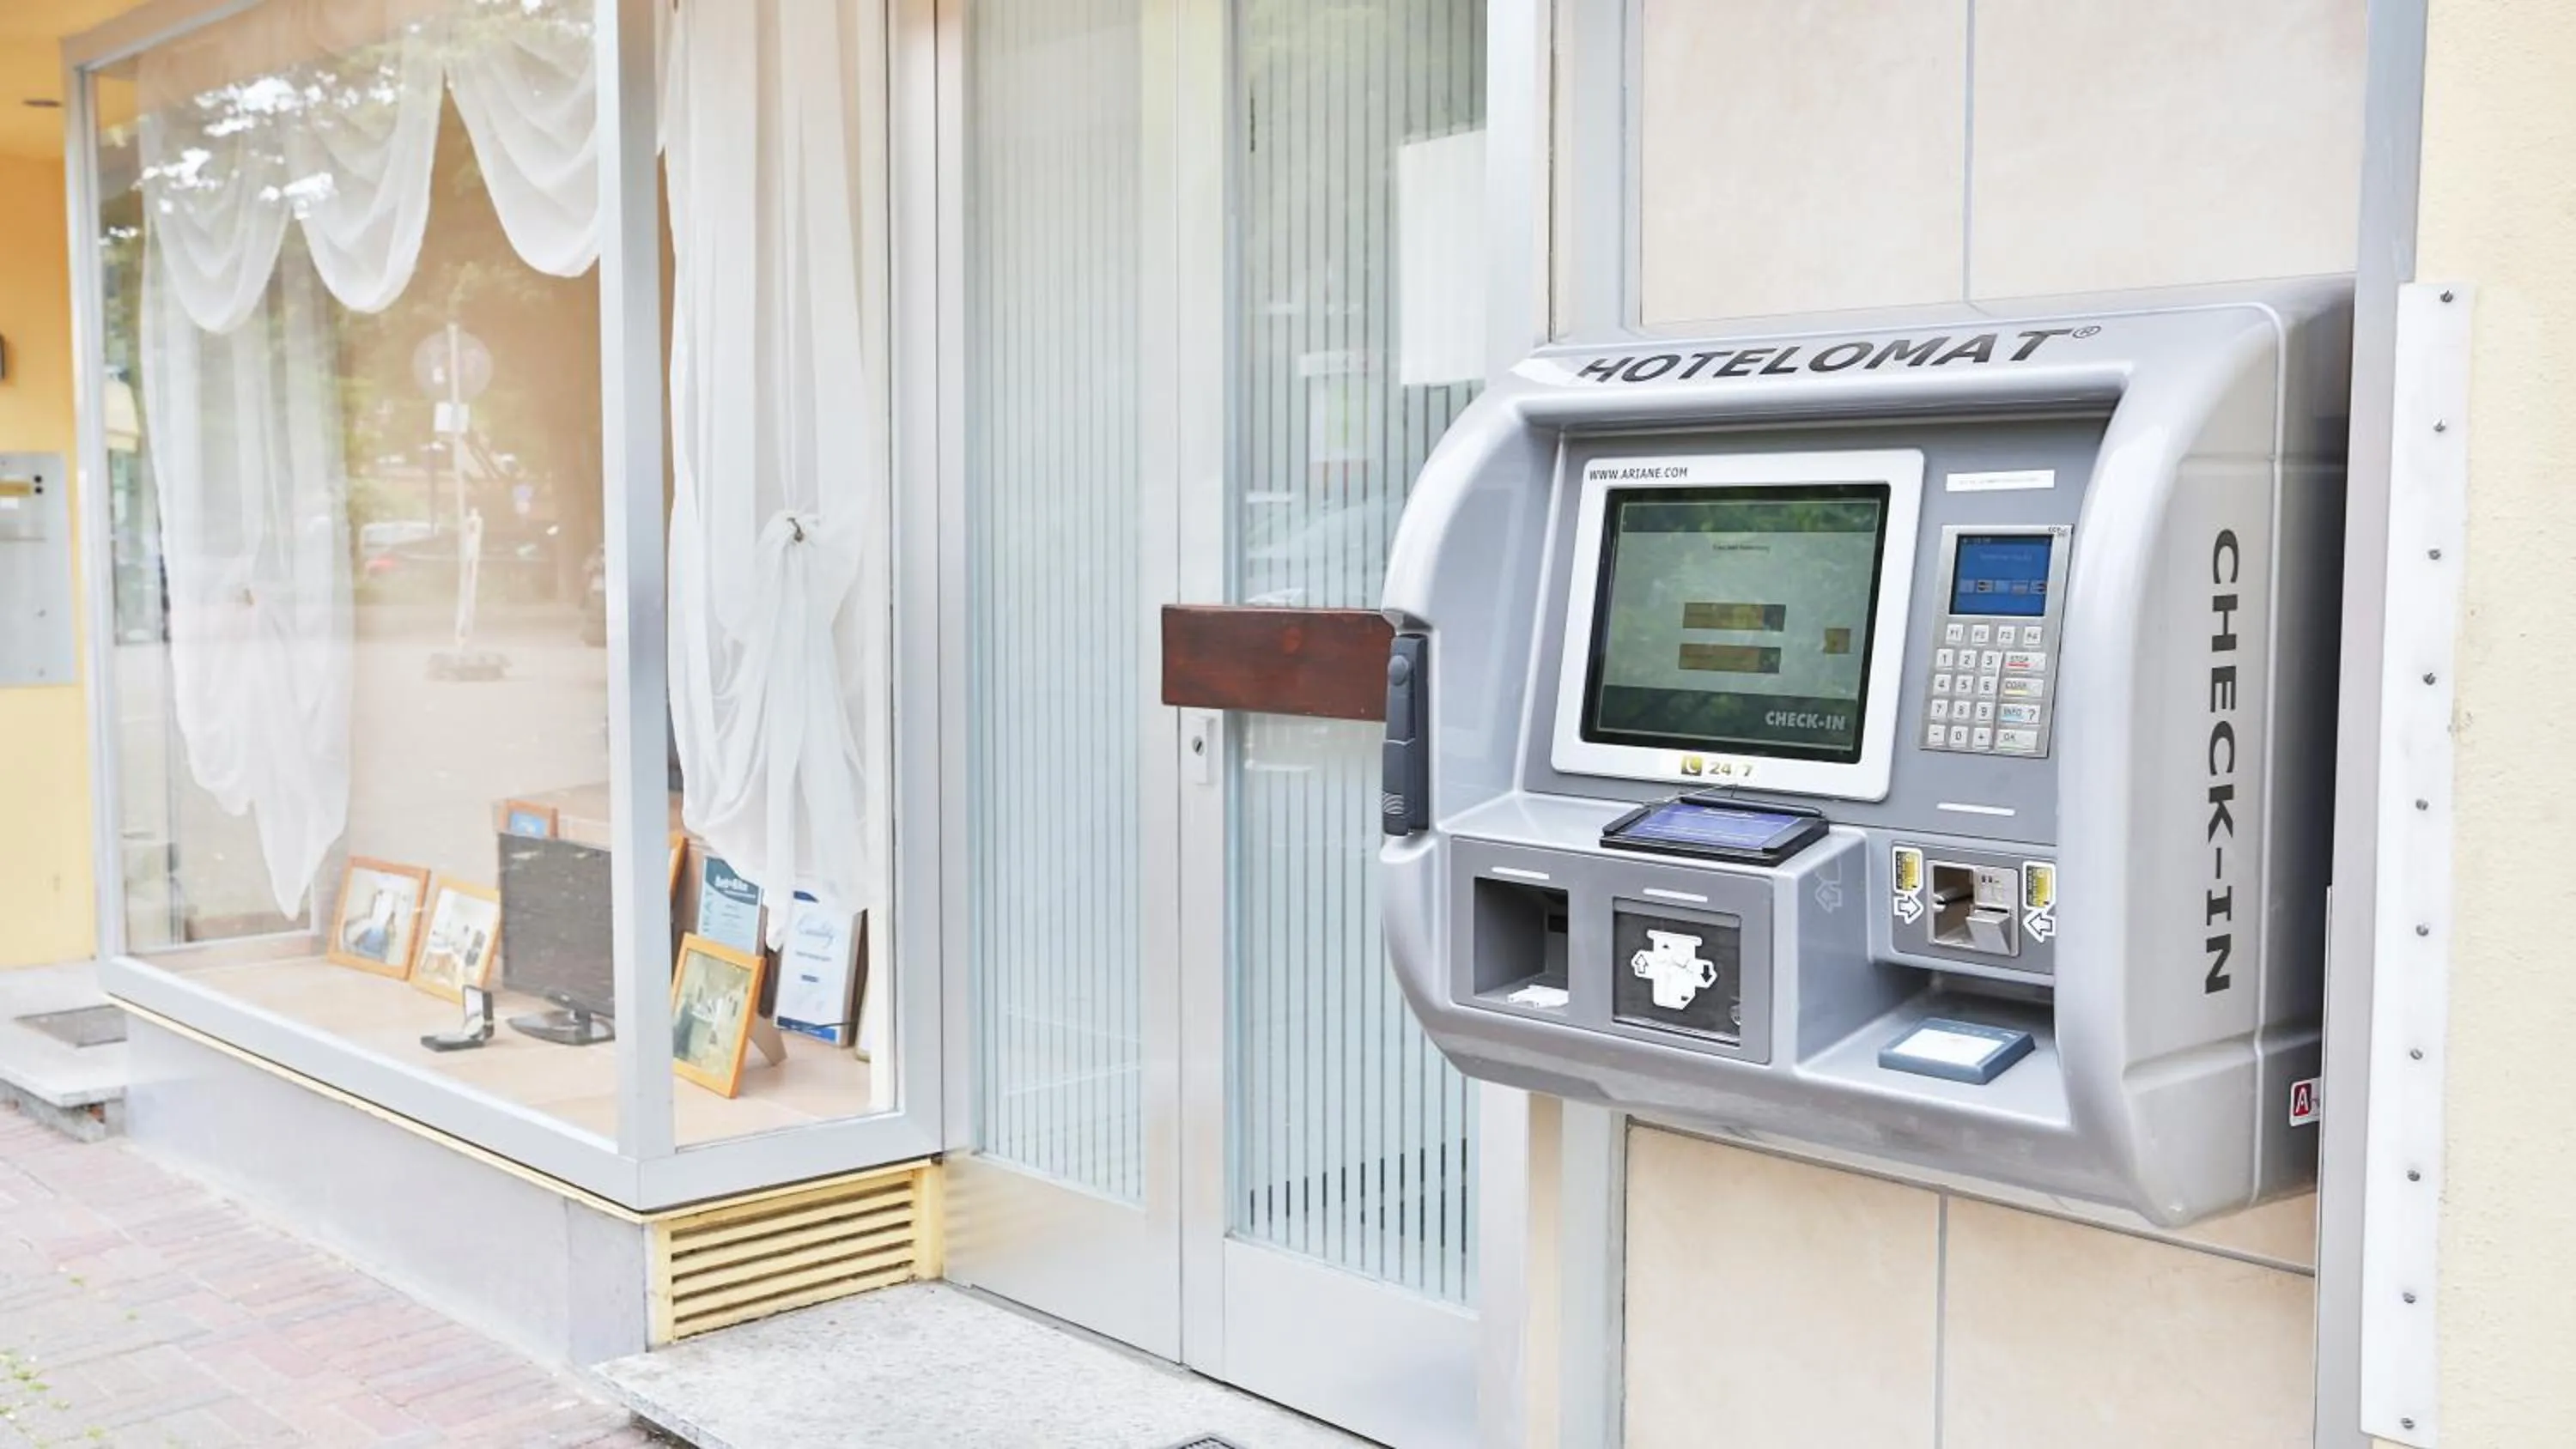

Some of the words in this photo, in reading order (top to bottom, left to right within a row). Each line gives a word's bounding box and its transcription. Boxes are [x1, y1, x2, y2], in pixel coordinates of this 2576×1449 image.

[1589, 467, 1687, 481] WWW.ARIANE.COM
[1765, 710, 1846, 731] CHECK-IN
[1708, 761, 1731, 776] 24
[2204, 527, 2239, 995] CHECK-IN
